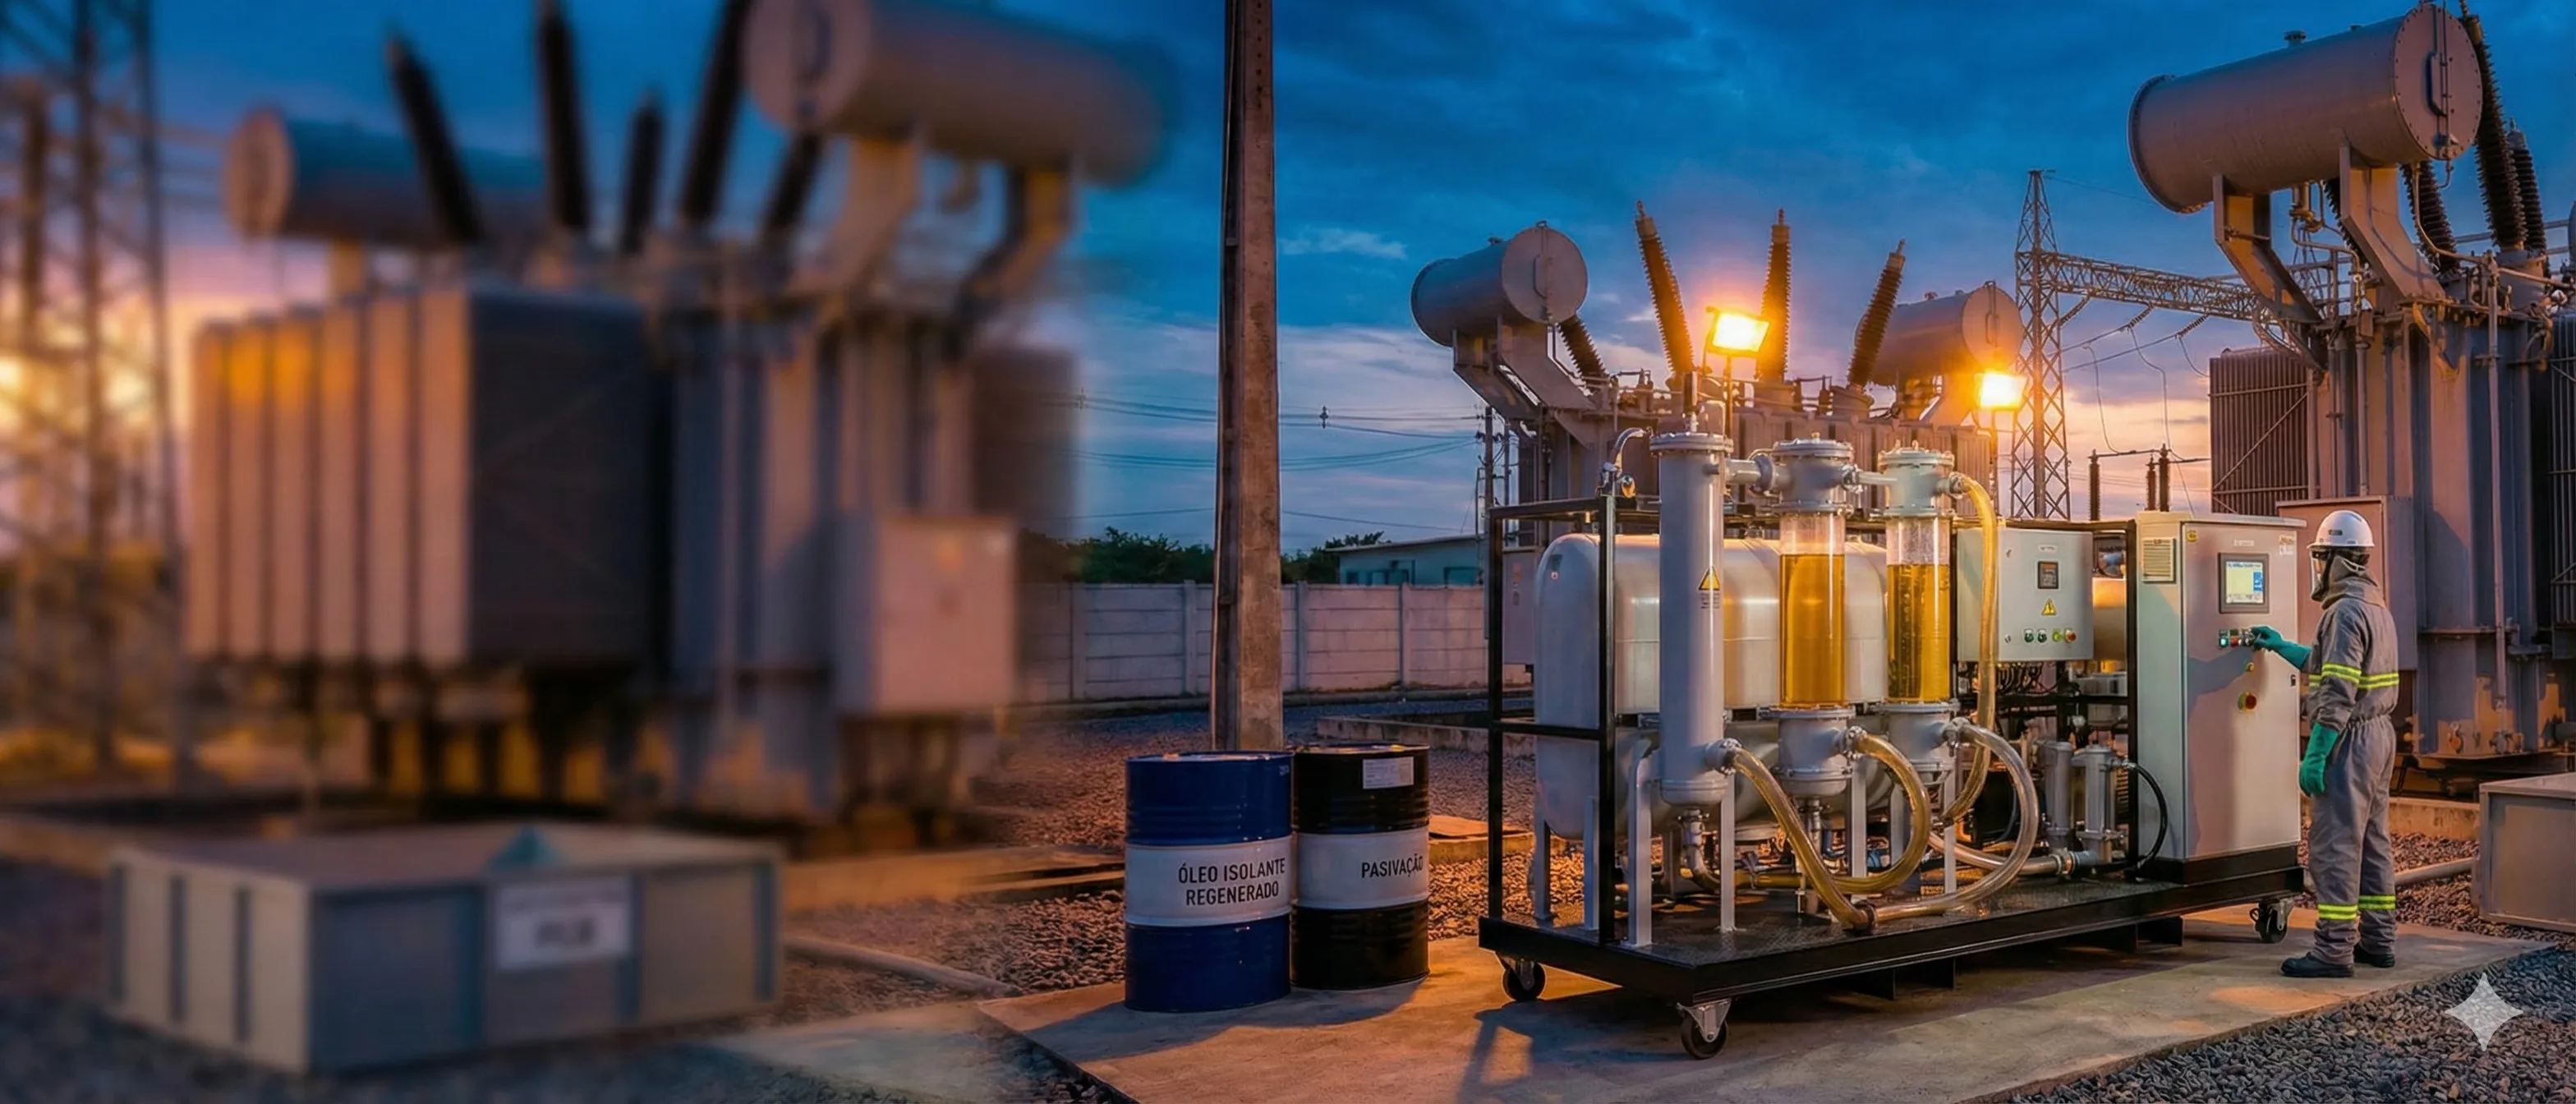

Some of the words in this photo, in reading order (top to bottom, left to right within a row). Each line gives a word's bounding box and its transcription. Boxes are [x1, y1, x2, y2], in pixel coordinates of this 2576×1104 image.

[1178, 863, 1218, 884] ÓLEO
[1223, 857, 1286, 881] ISOLANTE
[1185, 881, 1279, 905] REGENERADO
